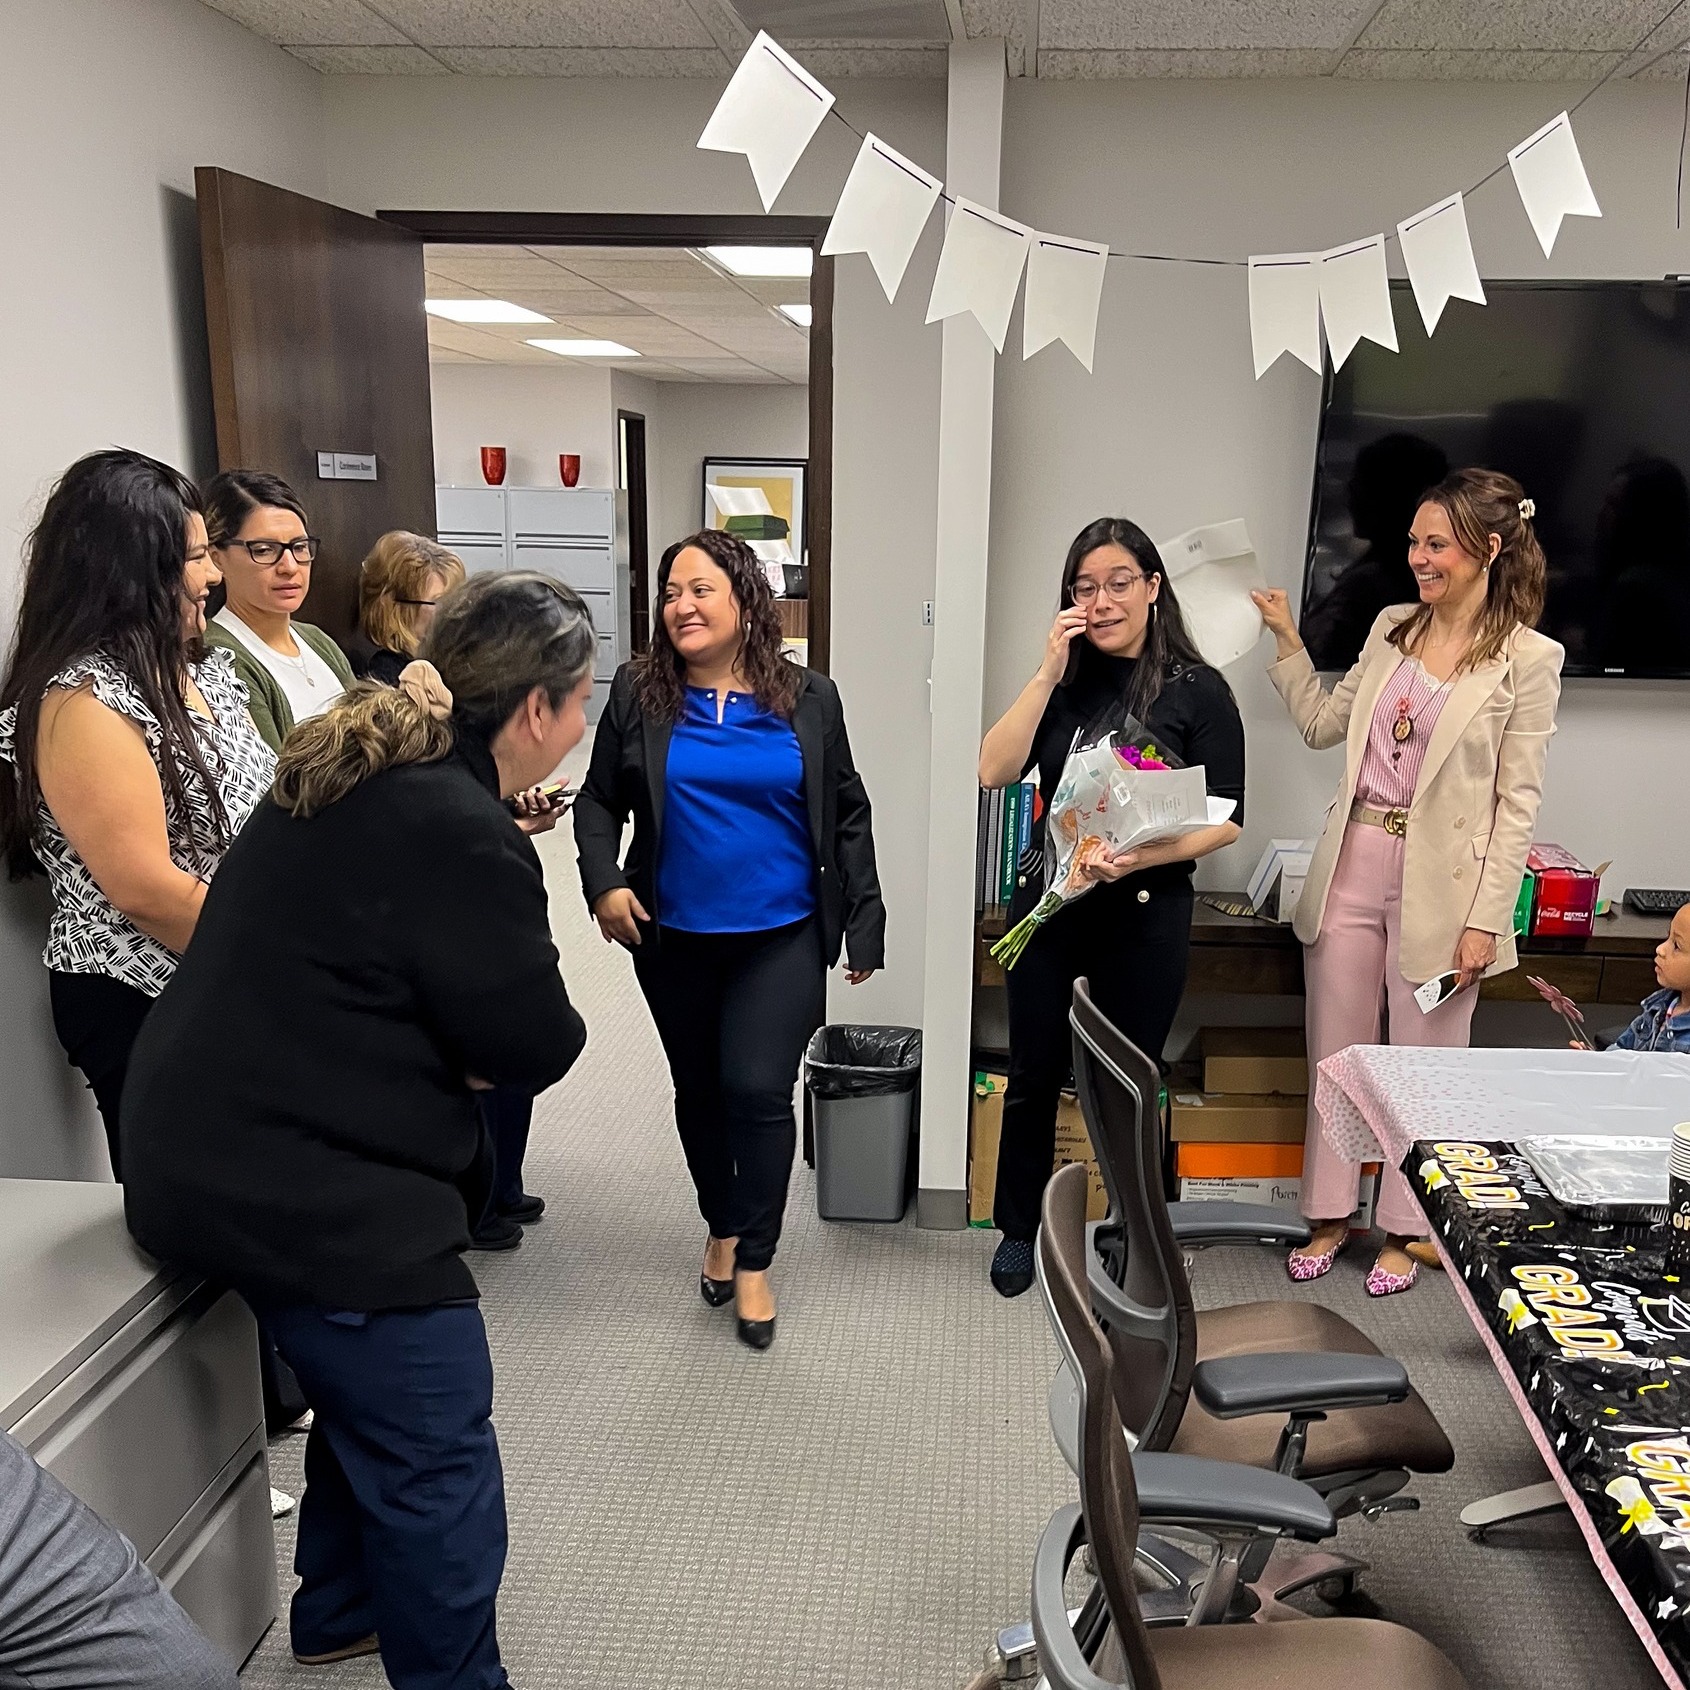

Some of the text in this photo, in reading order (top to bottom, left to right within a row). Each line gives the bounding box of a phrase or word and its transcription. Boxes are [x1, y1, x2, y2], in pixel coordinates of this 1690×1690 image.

[1007, 810, 1015, 851] LEGALIZATION
[1433, 1142, 1530, 1210] GRAD!
[1510, 1264, 1637, 1360] GRAD!
